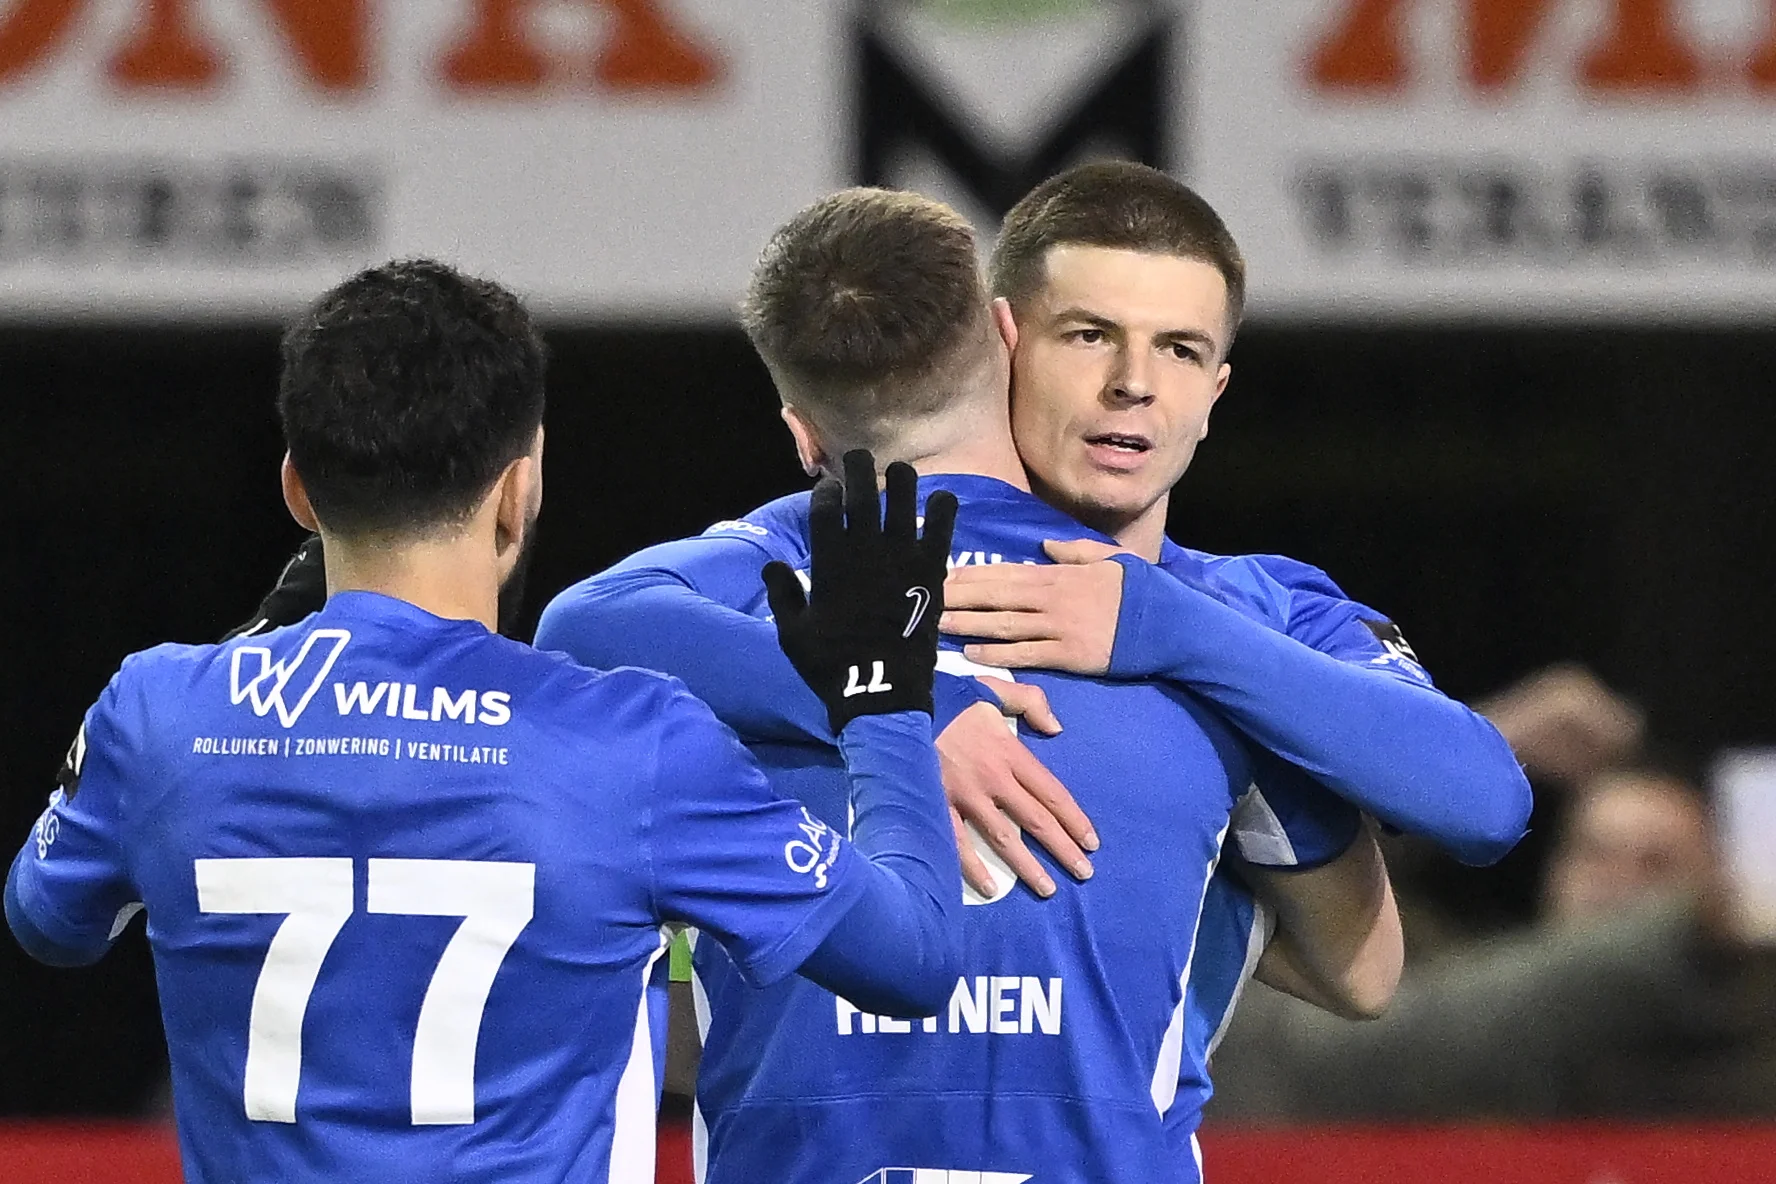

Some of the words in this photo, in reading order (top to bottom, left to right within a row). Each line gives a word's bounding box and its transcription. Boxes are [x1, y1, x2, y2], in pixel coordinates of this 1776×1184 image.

[334, 682, 511, 726] WILMS
[192, 736, 279, 756] ROLLUIKEN
[295, 737, 390, 757] ZONWERING
[408, 741, 510, 765] VENTILATIE
[194, 857, 536, 1125] 77
